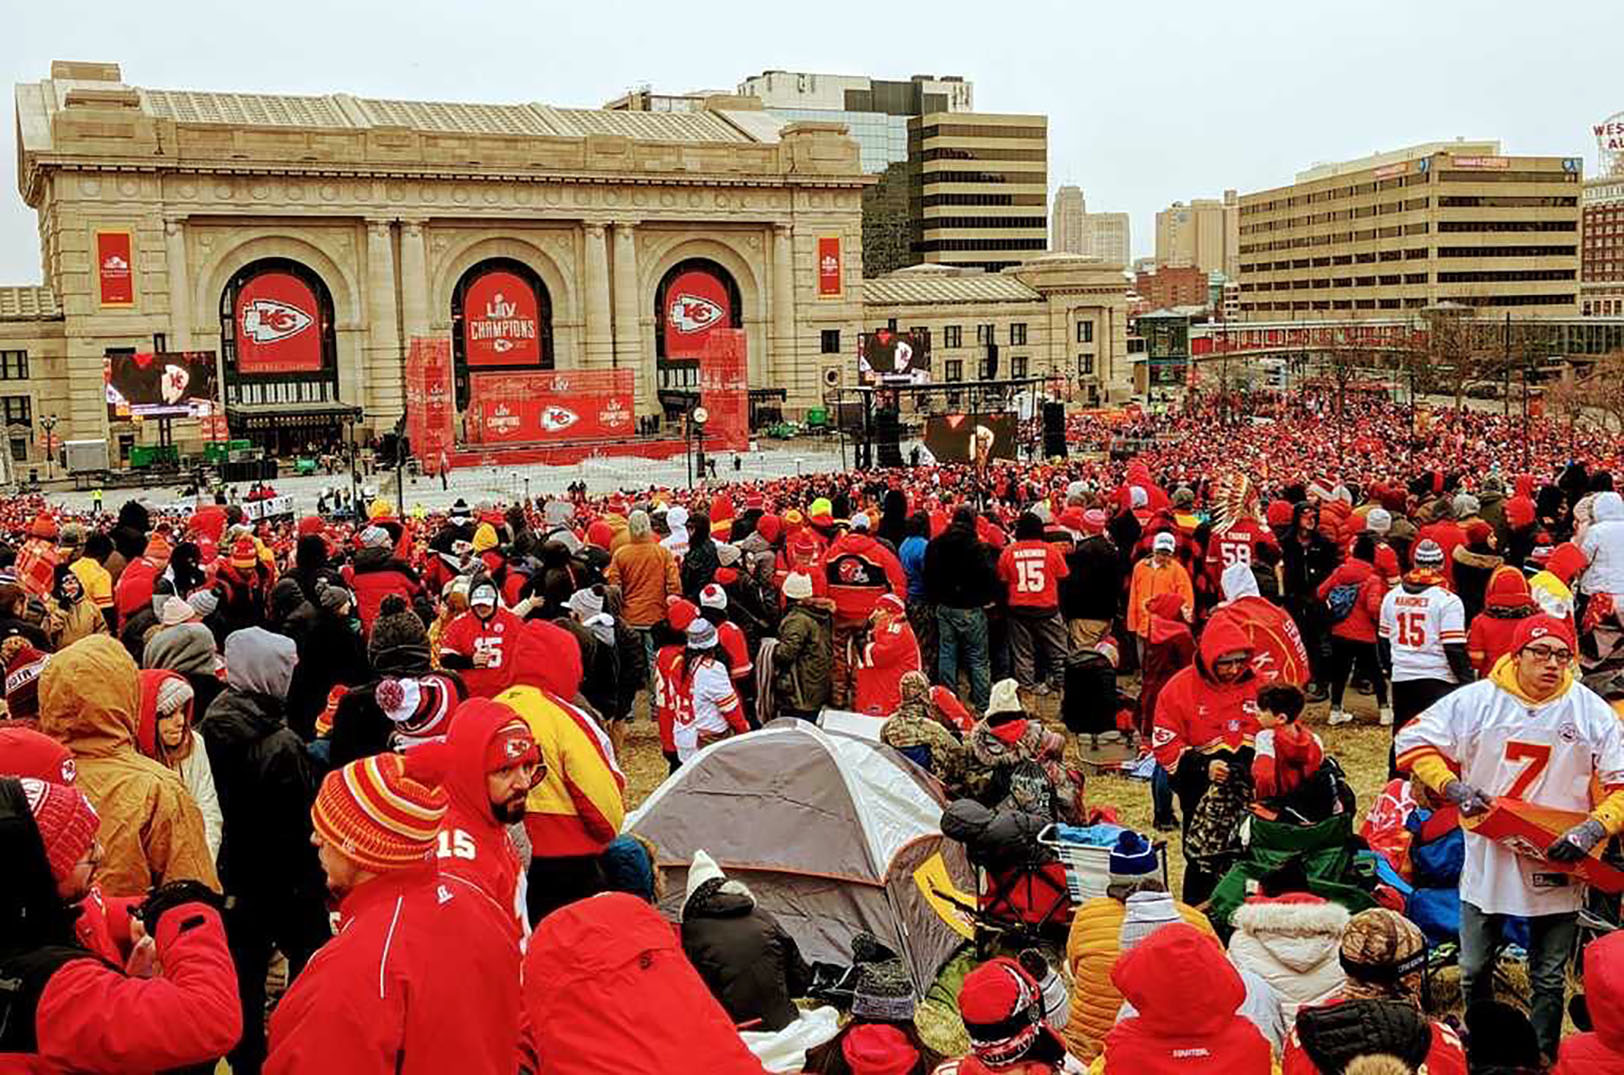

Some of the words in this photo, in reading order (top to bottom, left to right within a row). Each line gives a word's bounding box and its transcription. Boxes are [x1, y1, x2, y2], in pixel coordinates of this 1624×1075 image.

[471, 320, 535, 340] CHAMPIONS
[1220, 542, 1252, 567] 58
[1016, 560, 1046, 593] 15
[1396, 612, 1426, 648] 15
[1501, 739, 1554, 800] 7
[436, 828, 477, 861] 15
